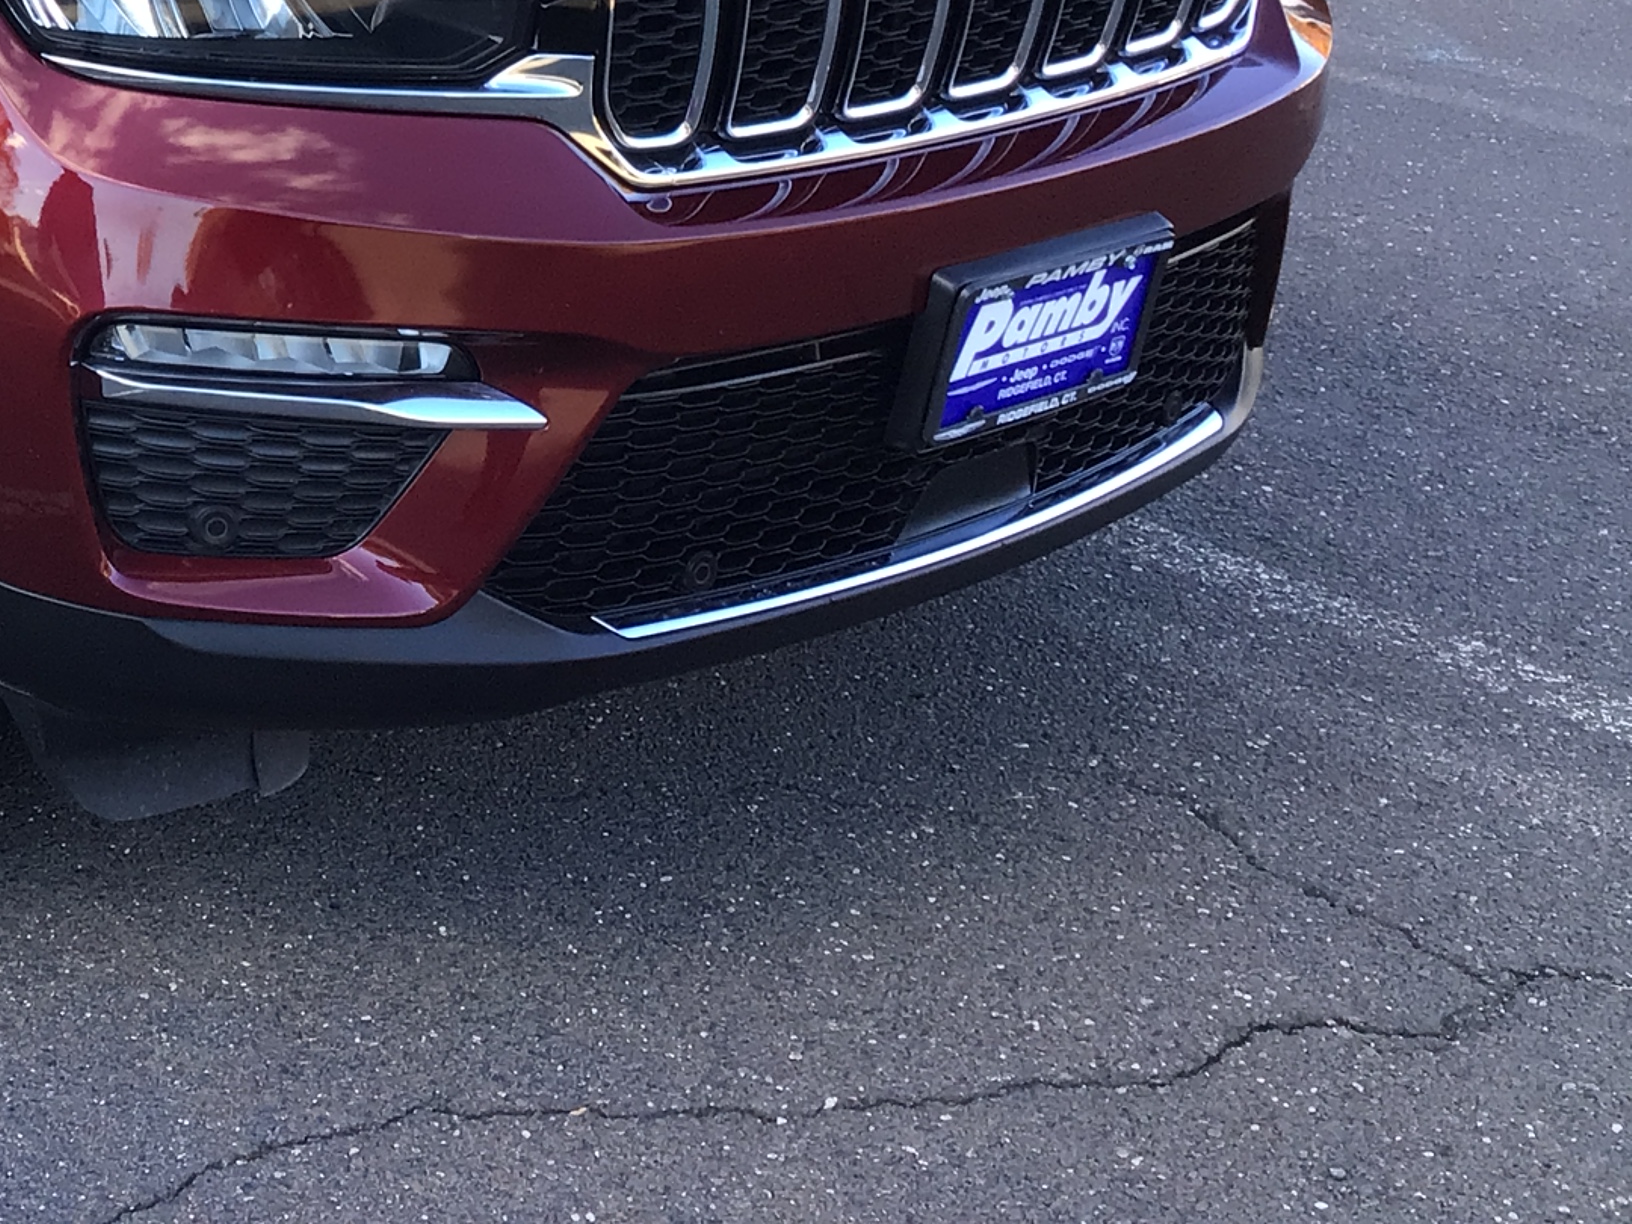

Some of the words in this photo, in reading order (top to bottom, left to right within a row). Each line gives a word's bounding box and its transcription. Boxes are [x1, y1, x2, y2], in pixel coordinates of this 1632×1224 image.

[1024, 248, 1127, 289] PAMBY
[949, 269, 1144, 383] Pamby
[979, 330, 1086, 370] MOTORS
[1009, 366, 1039, 383] Jeep
